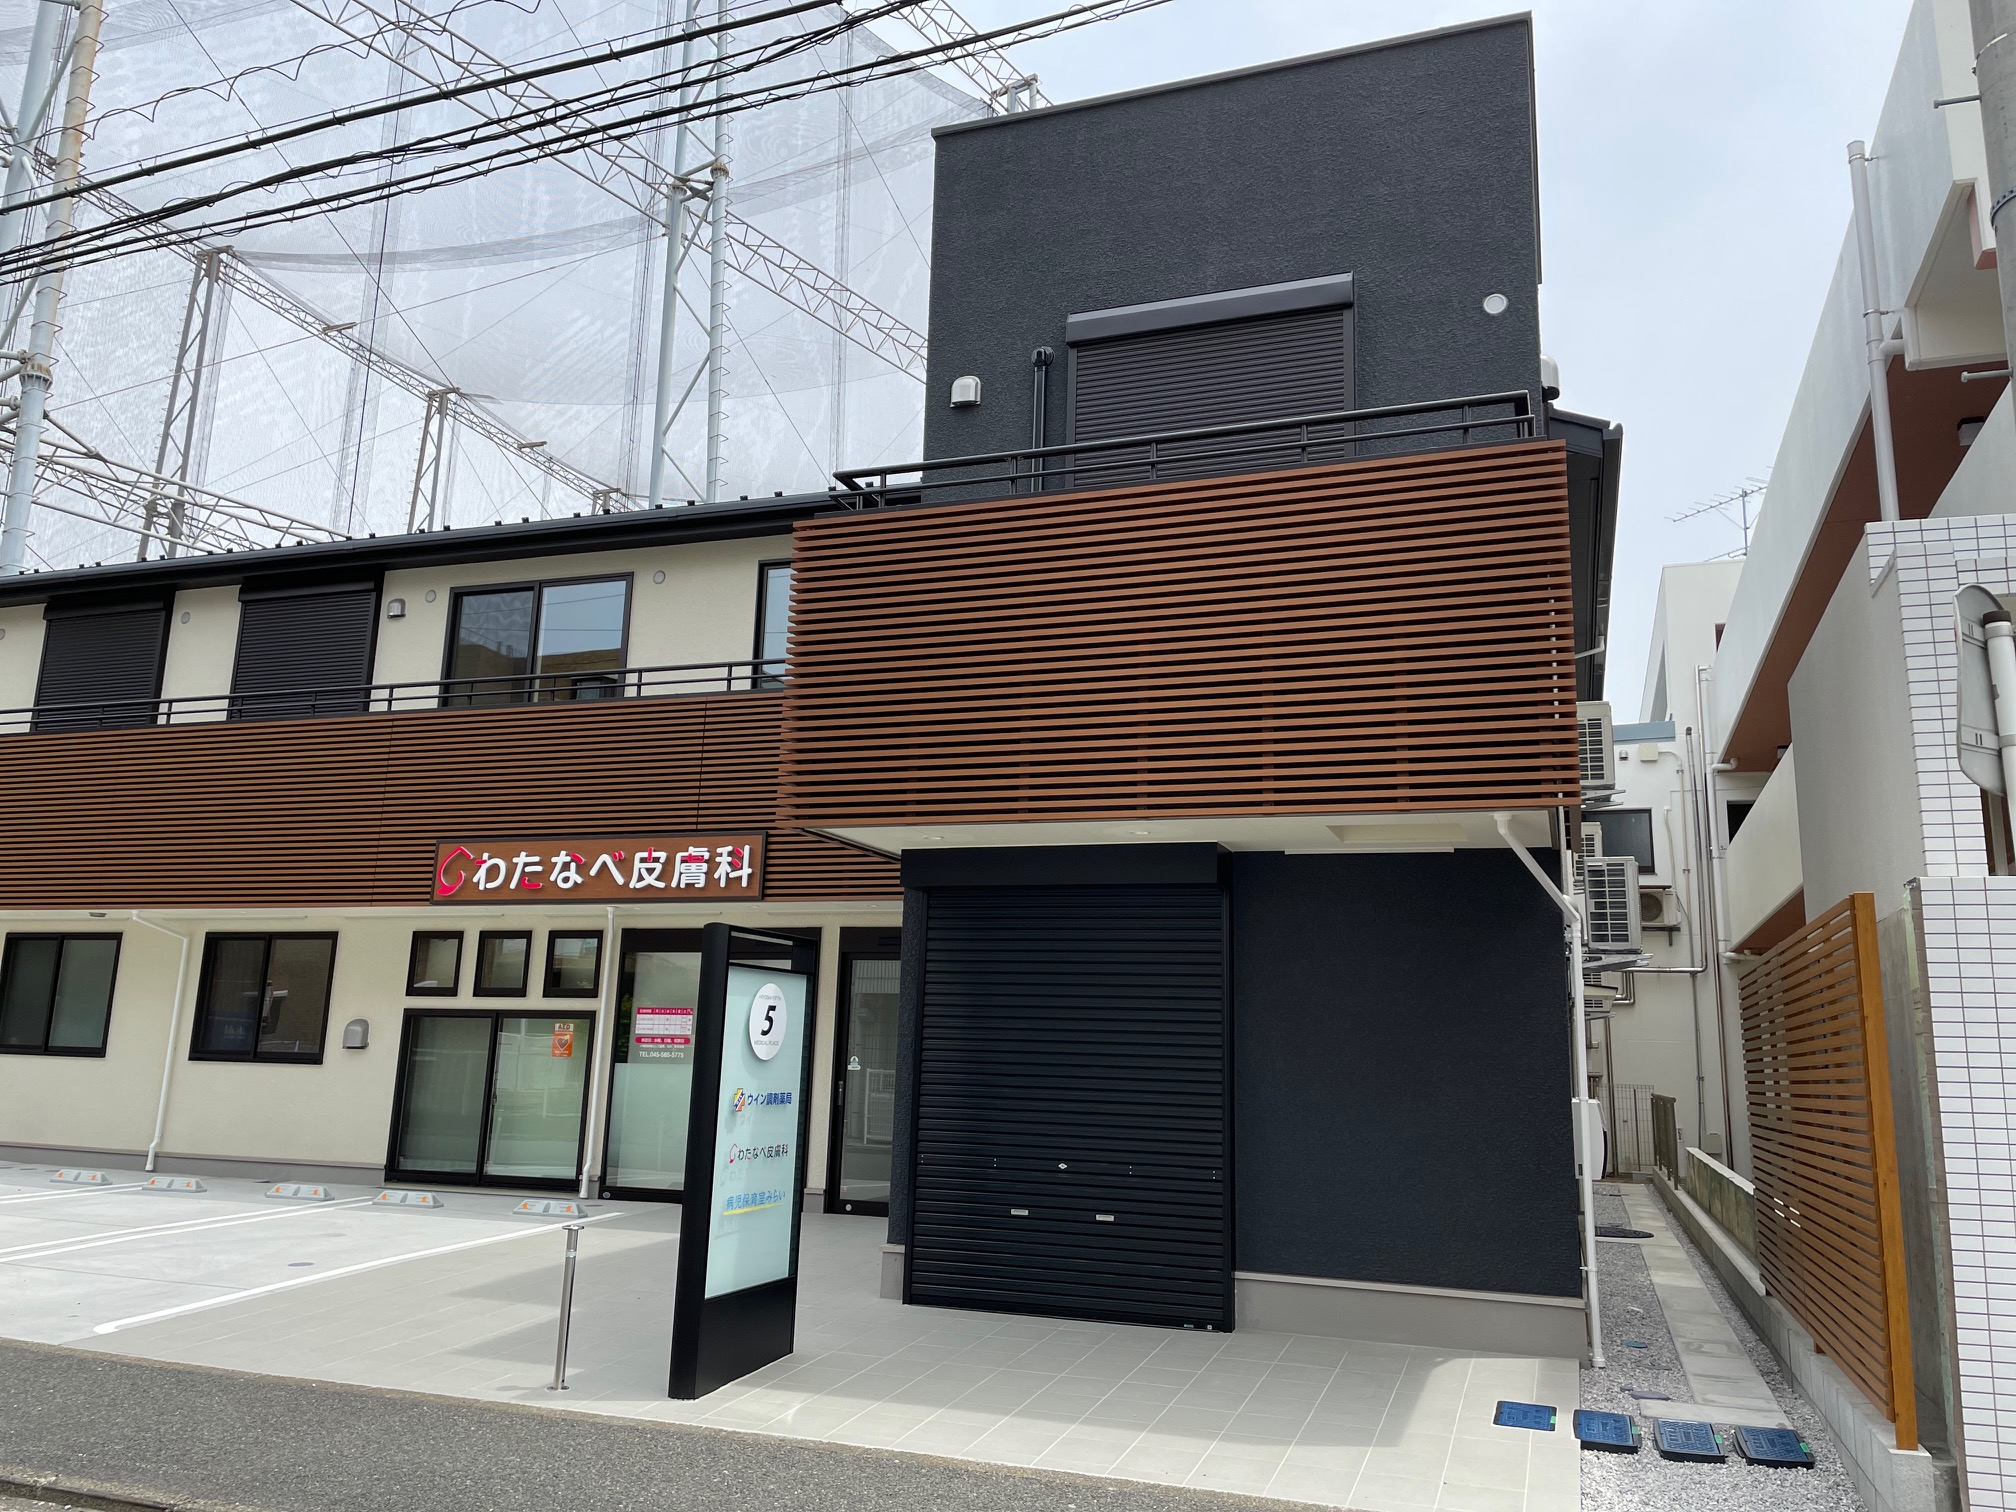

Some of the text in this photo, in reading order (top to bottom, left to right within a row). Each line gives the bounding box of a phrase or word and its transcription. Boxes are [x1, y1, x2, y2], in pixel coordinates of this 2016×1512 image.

[472, 844, 753, 891] わたなべ皮膚科
[760, 1004, 777, 1036] 5
[737, 1143, 789, 1161] わたなべ皮膚科
[726, 1189, 786, 1210] 病児保育室みらい
